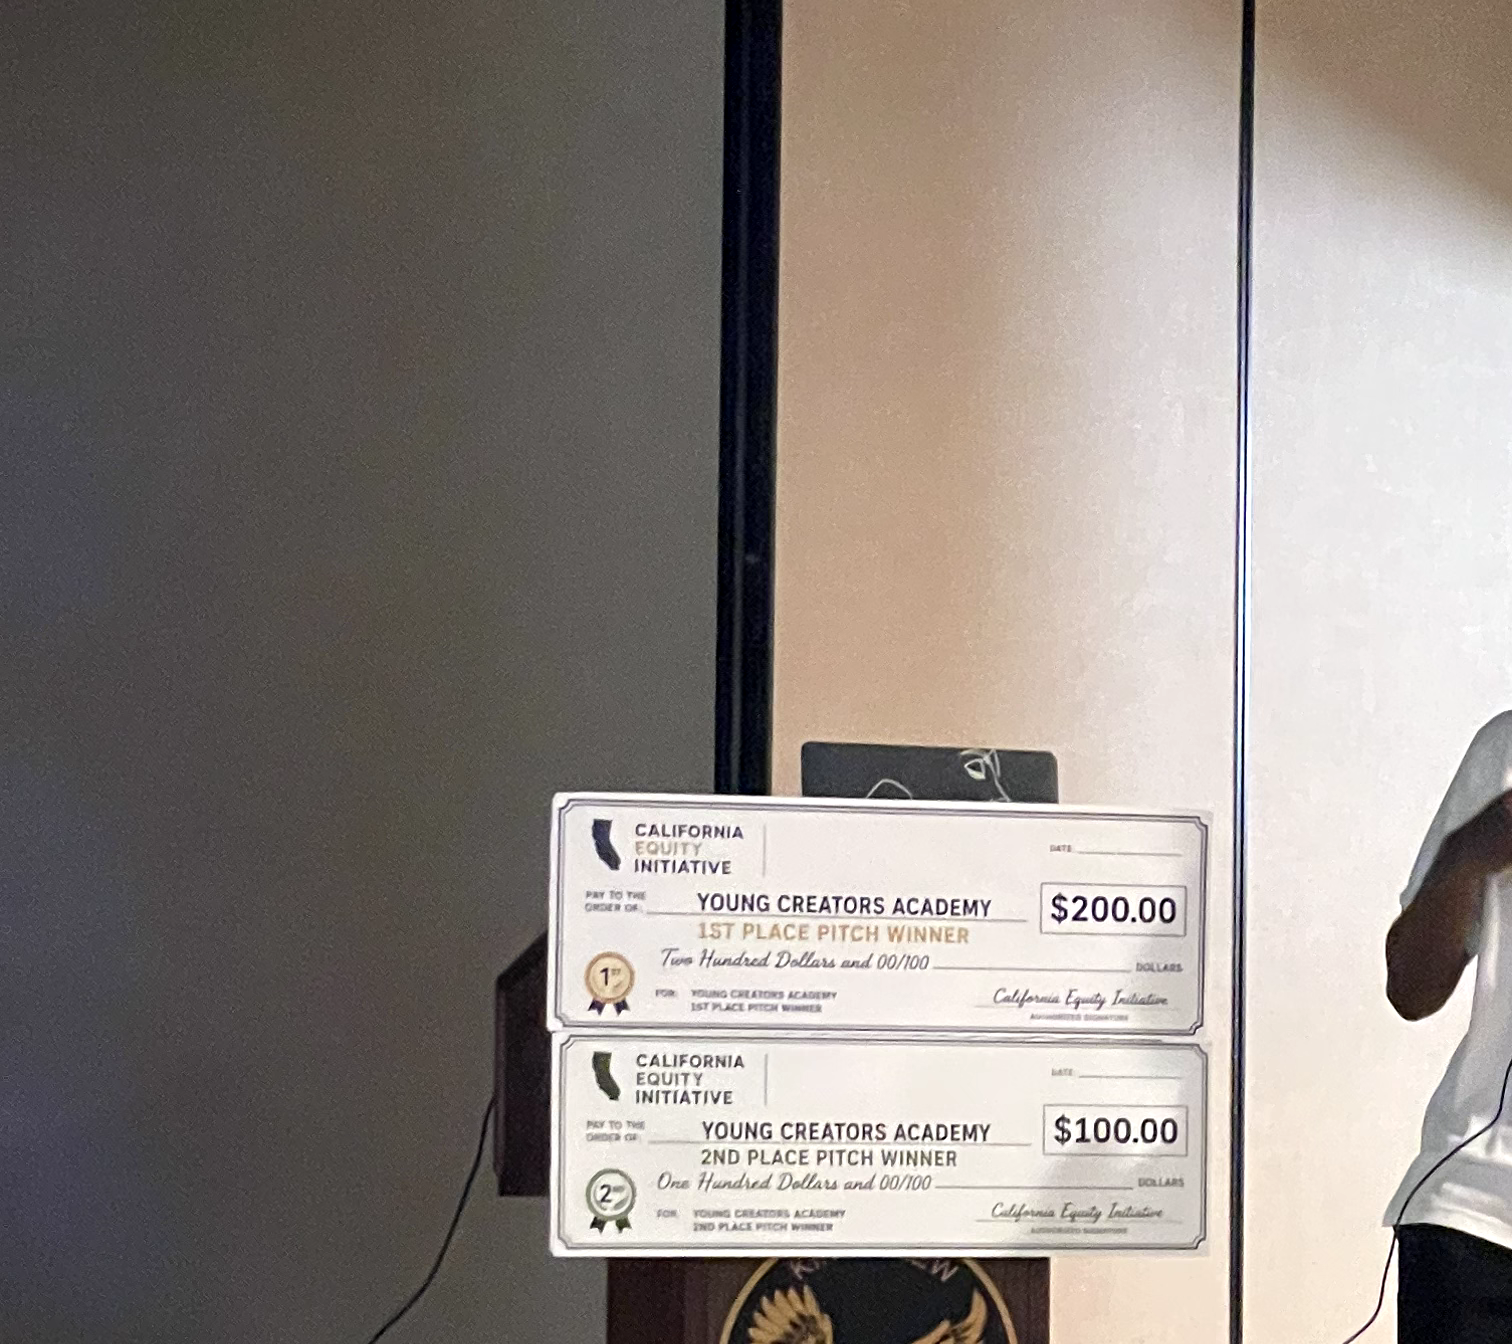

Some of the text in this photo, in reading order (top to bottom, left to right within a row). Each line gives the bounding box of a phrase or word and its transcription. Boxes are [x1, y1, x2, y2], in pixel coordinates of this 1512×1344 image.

[635, 823, 744, 839] CALIFORNIA
[635, 840, 703, 856] EQUITY
[634, 858, 732, 875] INITIATIVE
[585, 890, 605, 900] PAY
[608, 890, 623, 901] TO
[697, 892, 992, 918] YOUNG CREATORS ACADEMY
[1050, 892, 1178, 924] $200.00
[698, 922, 970, 945] 1ST PLACE PITCH WINNER
[661, 948, 930, 971] Two Hundred Dollars and 00/100
[691, 989, 728, 999] YOUNG
[730, 989, 785, 1000] CREATORS
[787, 990, 838, 1000] ACADEMY
[992, 987, 1169, 1011] California Equity Initiative
[711, 1003, 745, 1013] PLACE
[748, 1003, 779, 1013] PITCH
[635, 1053, 745, 1069] CALIFORNIA
[636, 1072, 704, 1087] EQUITY
[635, 1089, 734, 1106] INITIATIVE
[586, 1120, 606, 1130] PAY
[608, 1120, 623, 1130] TO
[701, 1120, 992, 1143] YOUNG CREATORS ACADEMY
[1053, 1114, 1179, 1146] $100.00
[701, 1148, 958, 1167] 2ND PLACE PITCH WINNER
[657, 1170, 932, 1193] One Hundred Dollars and 00/100
[693, 1208, 732, 1219] YOUNG
[734, 1208, 791, 1219] CREATORS
[793, 1208, 847, 1219] ACADEMY
[990, 1201, 1164, 1224] California Equity Initiative
[693, 1222, 716, 1232] 2ND
[717, 1222, 753, 1232] PLACE
[755, 1223, 788, 1232] PITCH
